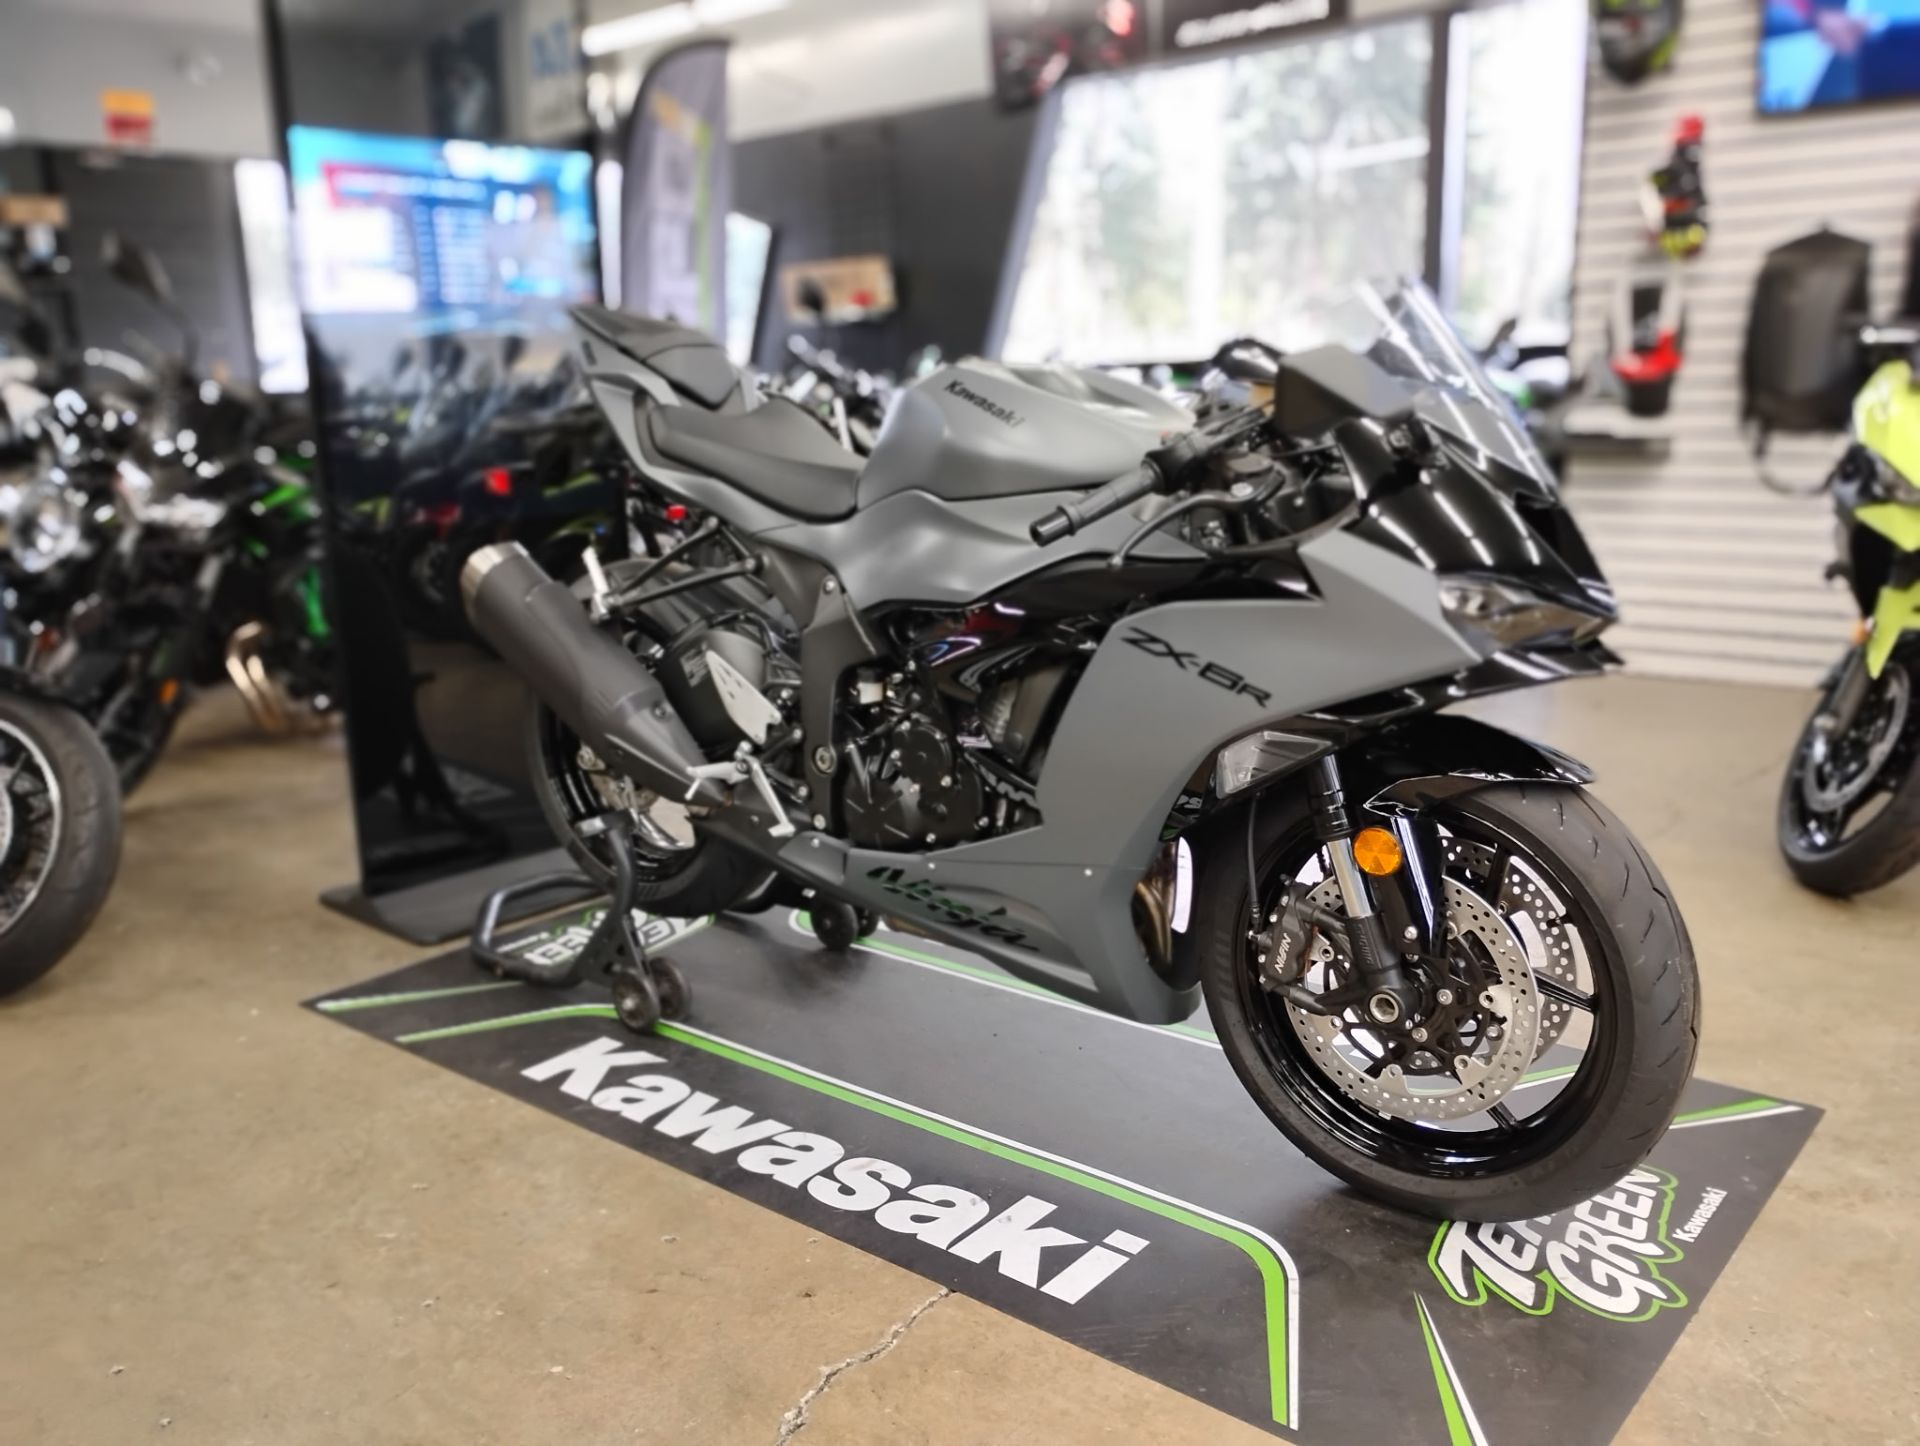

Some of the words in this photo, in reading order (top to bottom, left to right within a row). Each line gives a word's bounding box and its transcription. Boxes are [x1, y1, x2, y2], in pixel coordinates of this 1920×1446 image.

[944, 380, 1026, 428] Kawasaki
[1120, 626, 1272, 708] ZX-6R
[520, 1036, 1150, 1305] Kawasaki
[1545, 1167, 1668, 1314] GREEN
[1673, 1187, 1728, 1243] Kawasaki
[1437, 1214, 1557, 1306] TE
